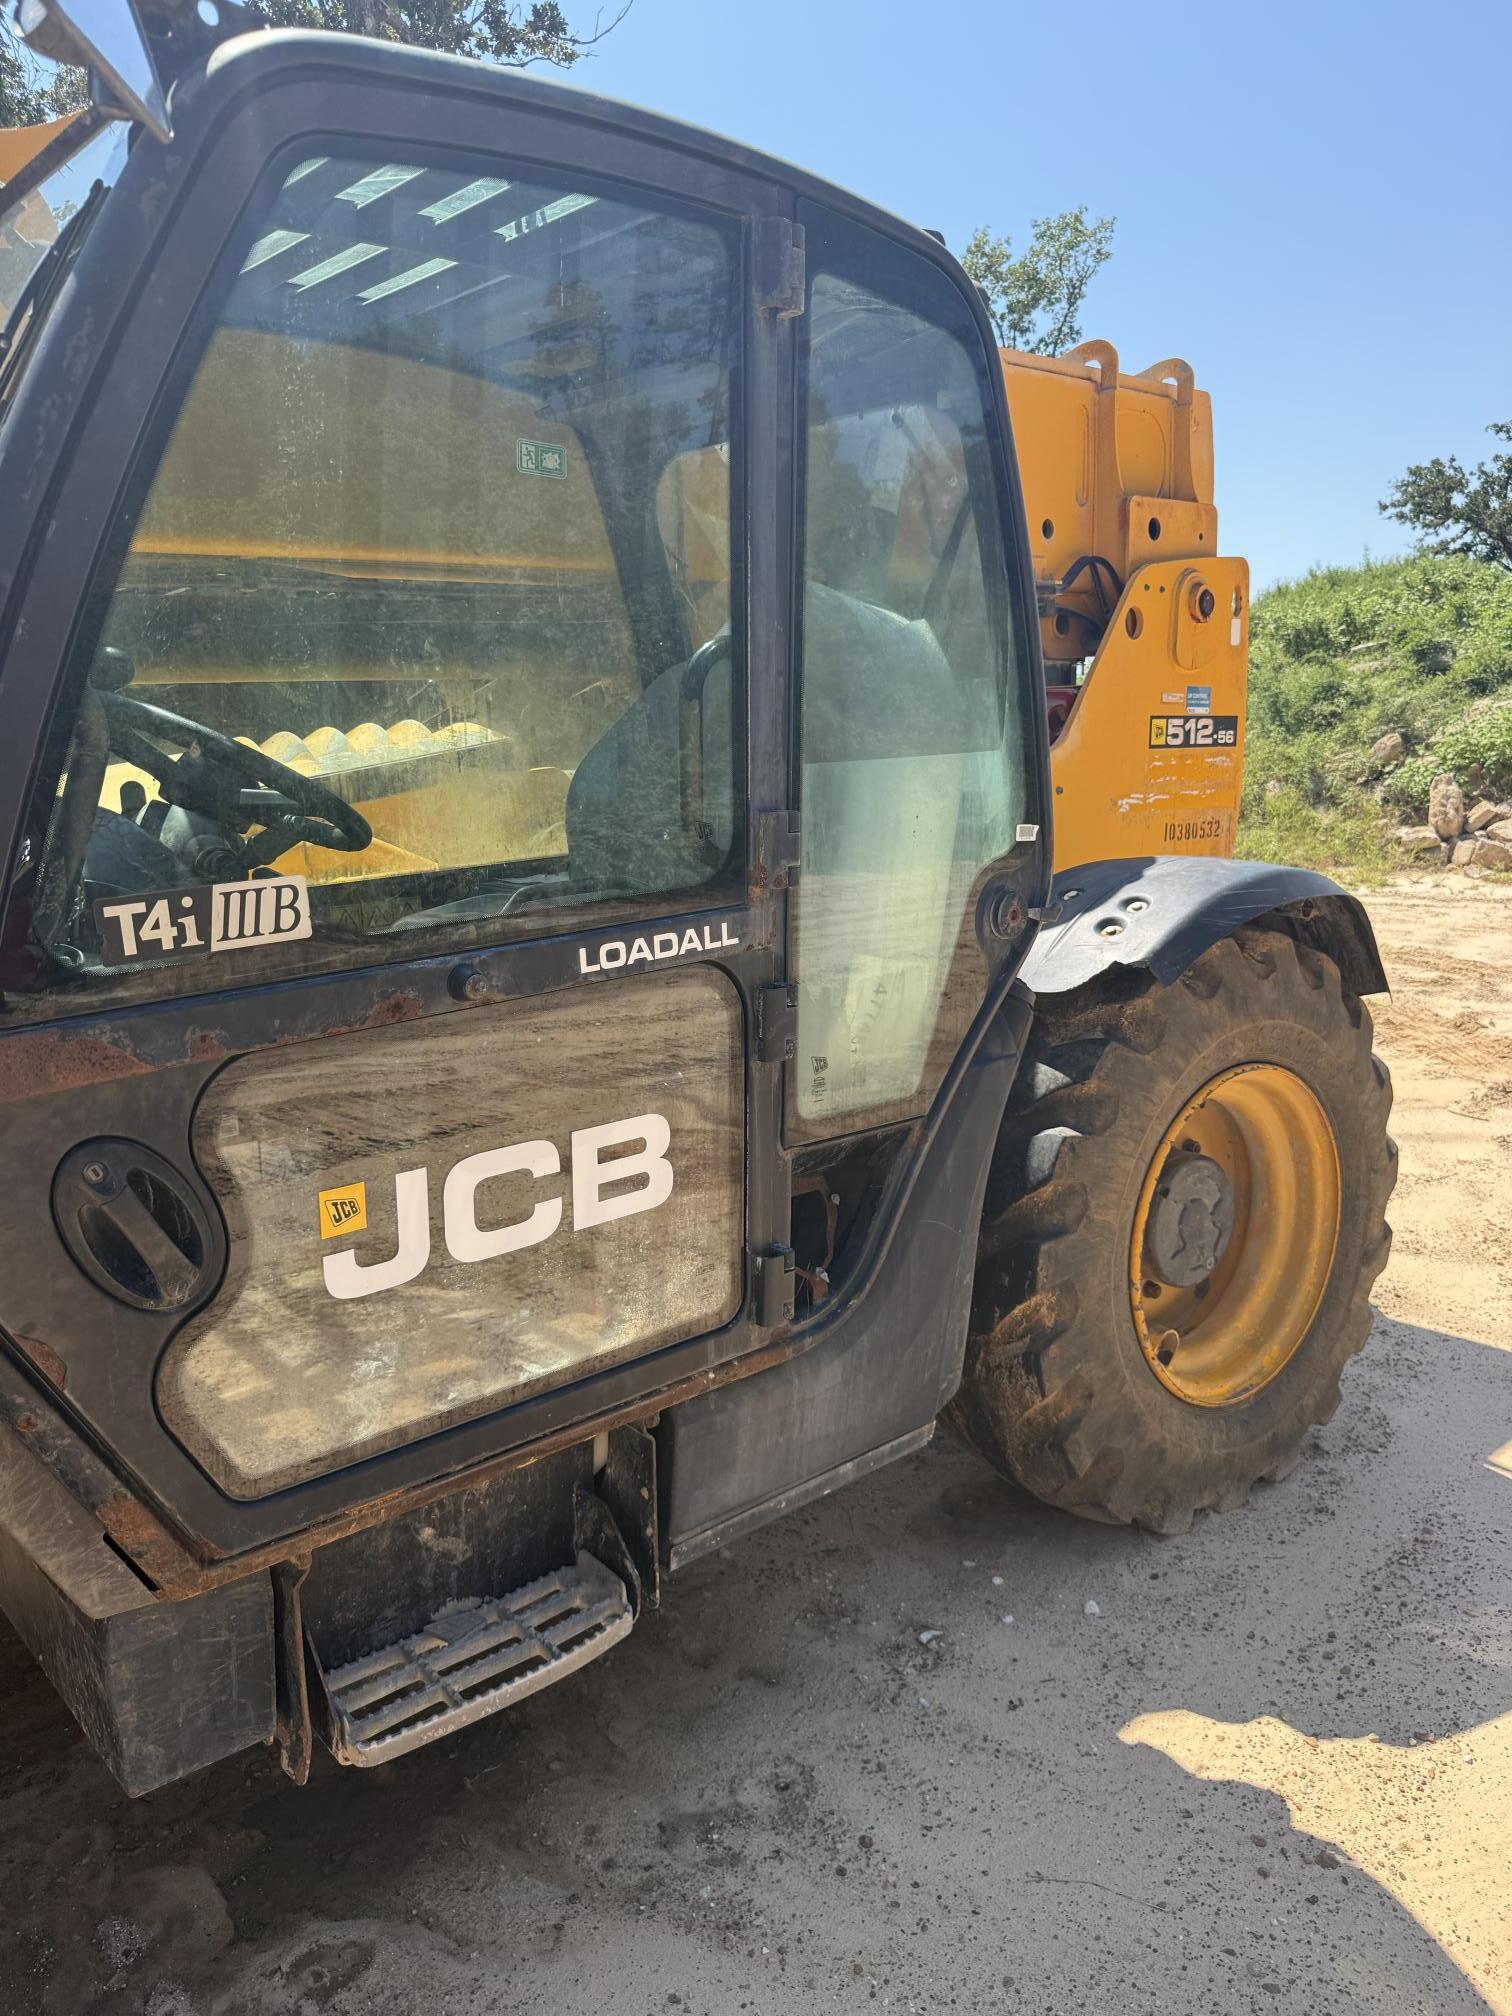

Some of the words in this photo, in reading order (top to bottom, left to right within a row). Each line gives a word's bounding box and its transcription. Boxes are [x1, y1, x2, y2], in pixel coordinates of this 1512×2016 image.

[1163, 819, 1221, 842] 10380532
[103, 896, 204, 956] T4i
[579, 922, 739, 974] LOADALL
[322, 1113, 674, 1299] JCB
[331, 1200, 358, 1224] JCB
